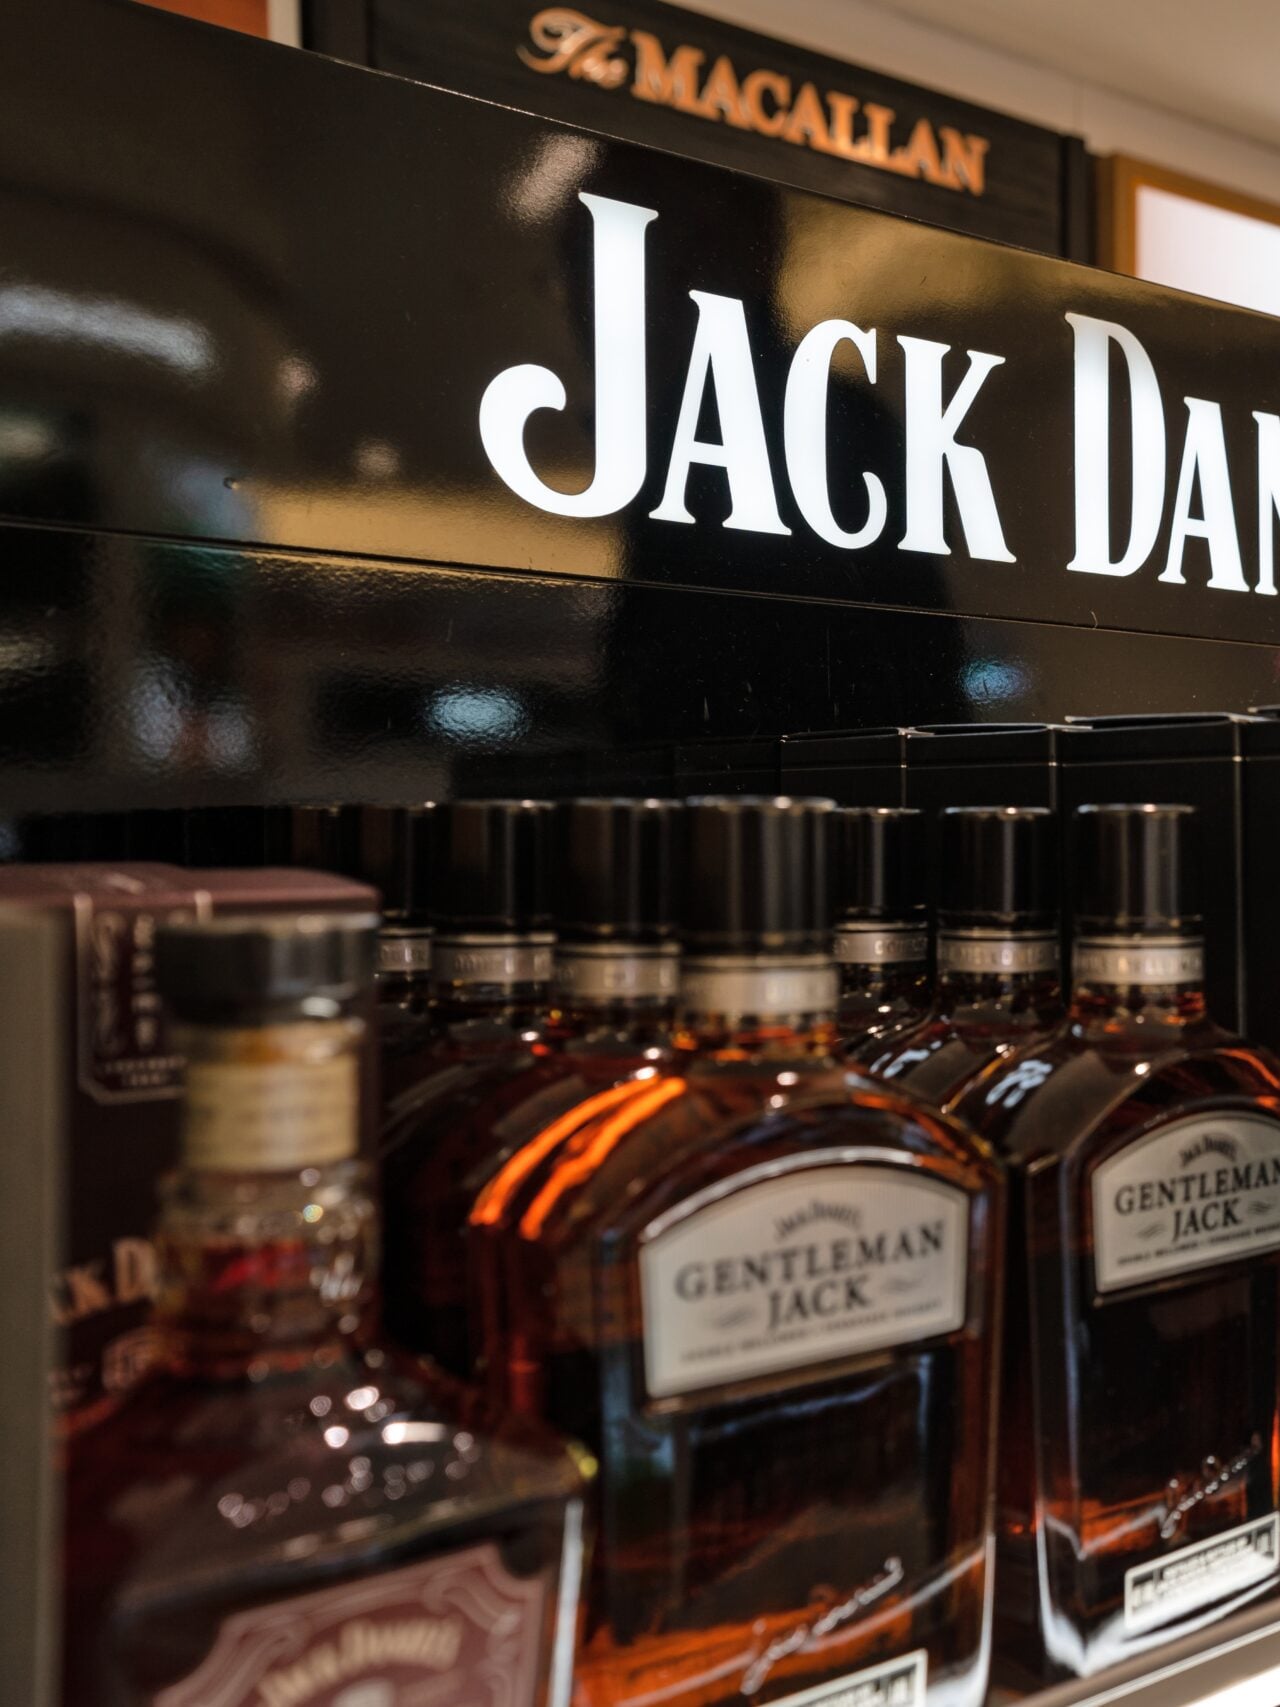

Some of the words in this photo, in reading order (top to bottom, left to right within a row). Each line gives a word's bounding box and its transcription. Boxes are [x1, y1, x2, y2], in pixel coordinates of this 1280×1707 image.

[516, 8, 630, 89] The
[630, 31, 990, 196] MACALLAN
[478, 192, 1018, 564] JACK
[674, 1219, 945, 1302] GENTLEMAN
[1171, 1197, 1242, 1244] JACK
[766, 1273, 870, 1333] JACK
